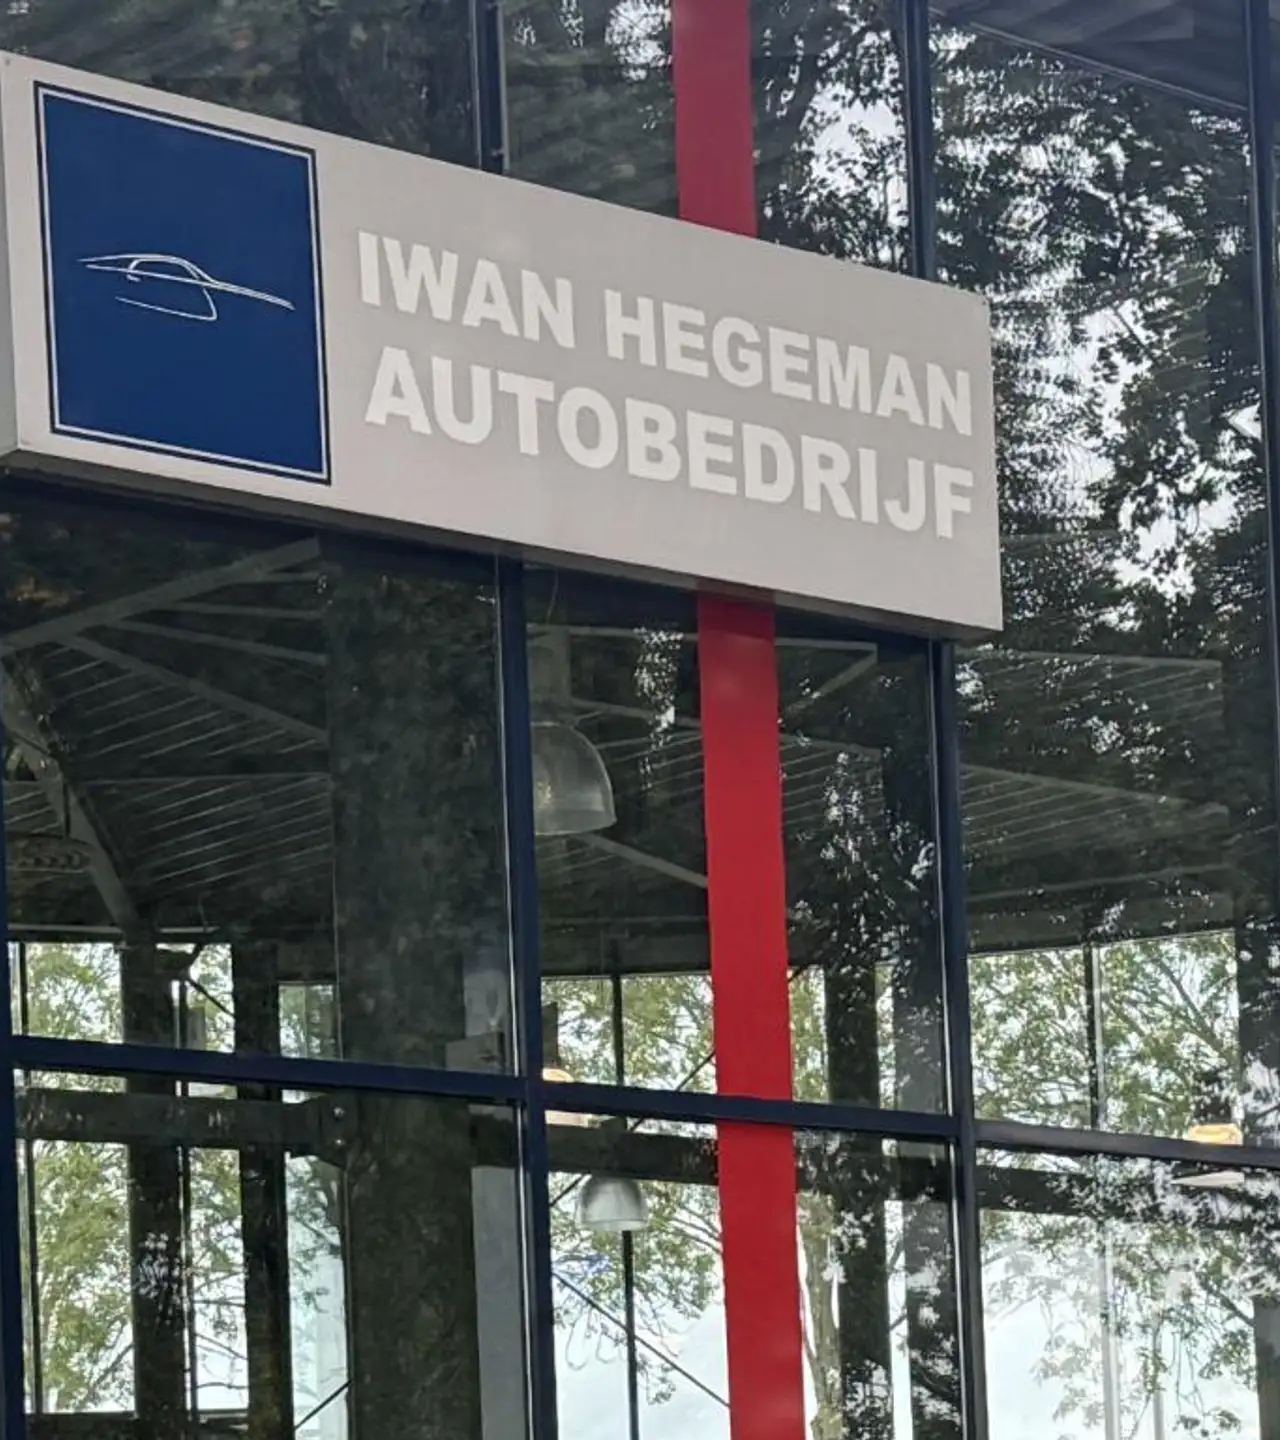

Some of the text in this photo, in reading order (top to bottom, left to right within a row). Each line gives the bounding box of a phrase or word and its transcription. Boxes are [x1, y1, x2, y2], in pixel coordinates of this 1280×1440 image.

[358, 231, 973, 437] IWAN HEGEMAN
[365, 346, 974, 538] AUTOBEDRIJF
